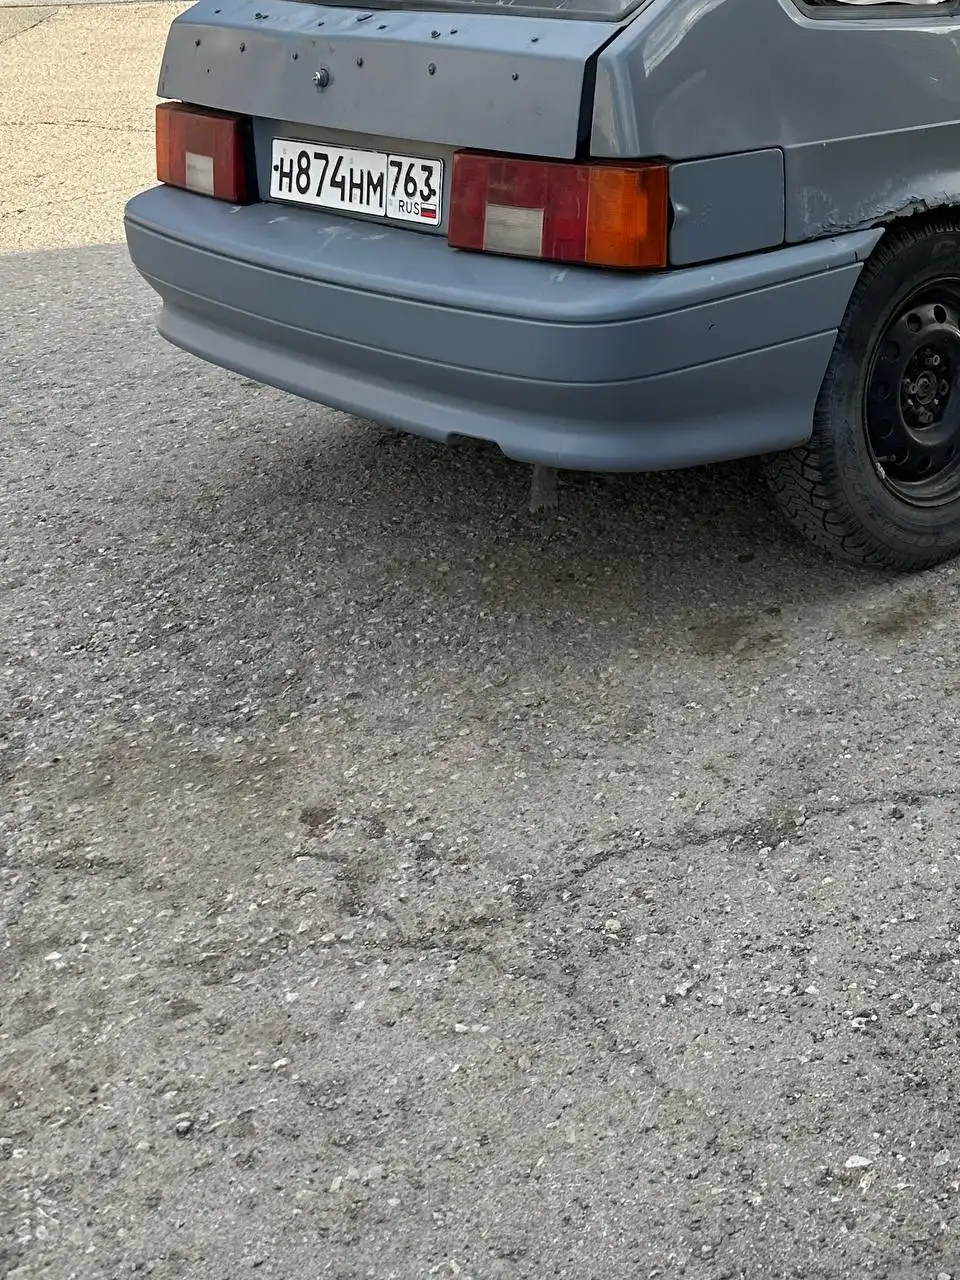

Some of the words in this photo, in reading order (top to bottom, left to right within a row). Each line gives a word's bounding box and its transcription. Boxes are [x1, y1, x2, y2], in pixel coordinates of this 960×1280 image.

[278, 150, 384, 208] Н874НМ
[389, 160, 434, 202] 763
[399, 200, 420, 216] RUS
